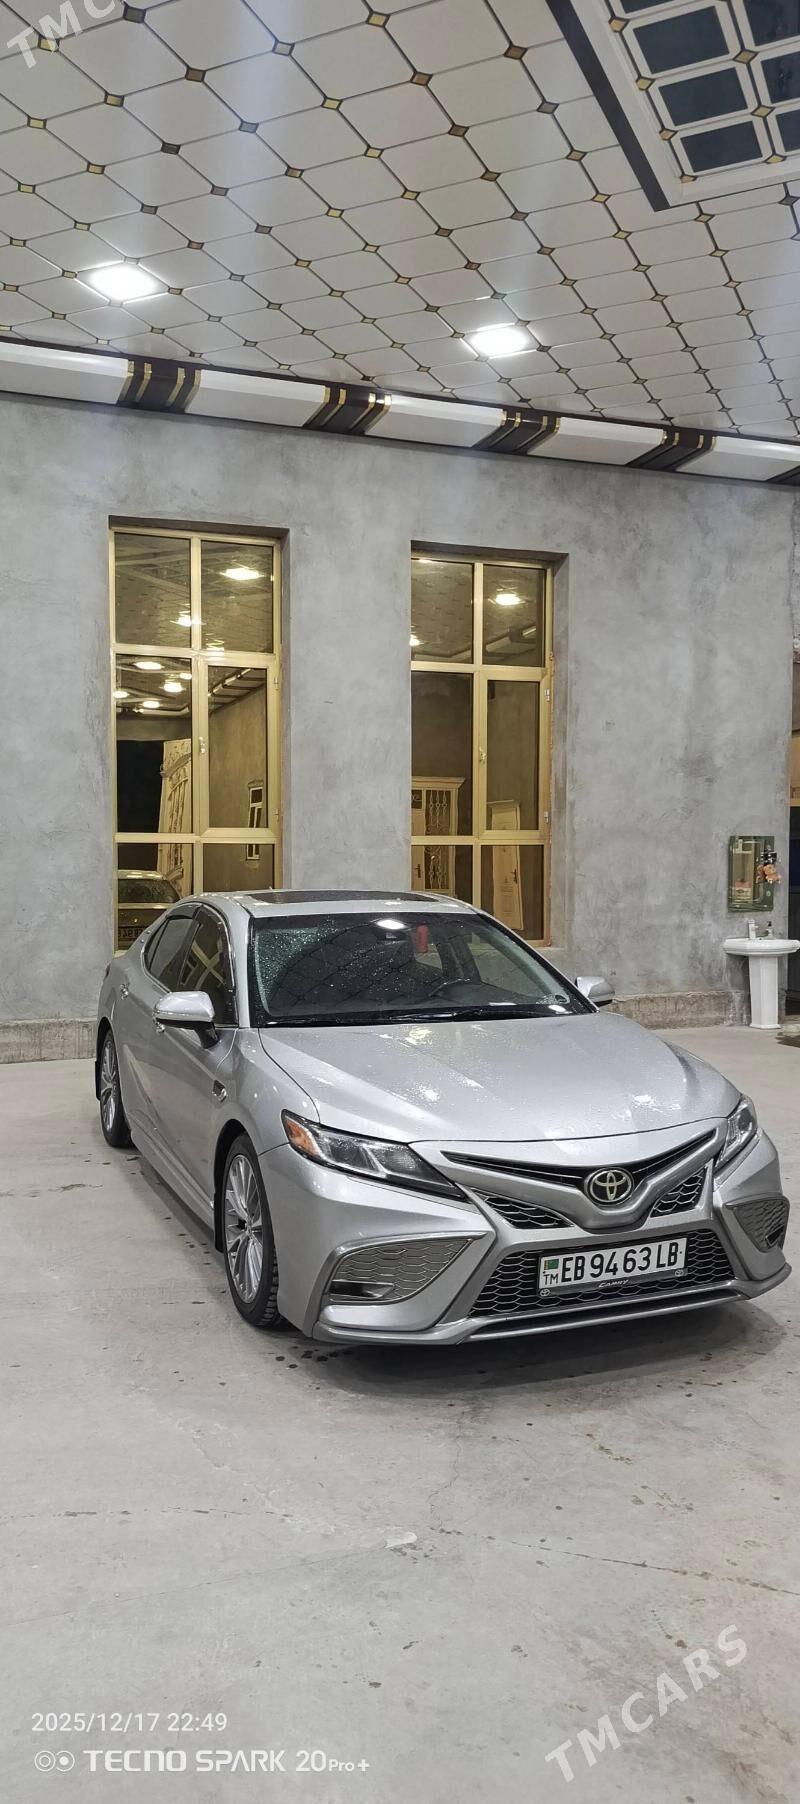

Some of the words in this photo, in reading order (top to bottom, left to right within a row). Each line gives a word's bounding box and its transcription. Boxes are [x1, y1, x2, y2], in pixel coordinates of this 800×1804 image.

[561, 1255, 585, 1283] EB
[656, 1242, 679, 1269] LB
[543, 1273, 559, 1286] TM
